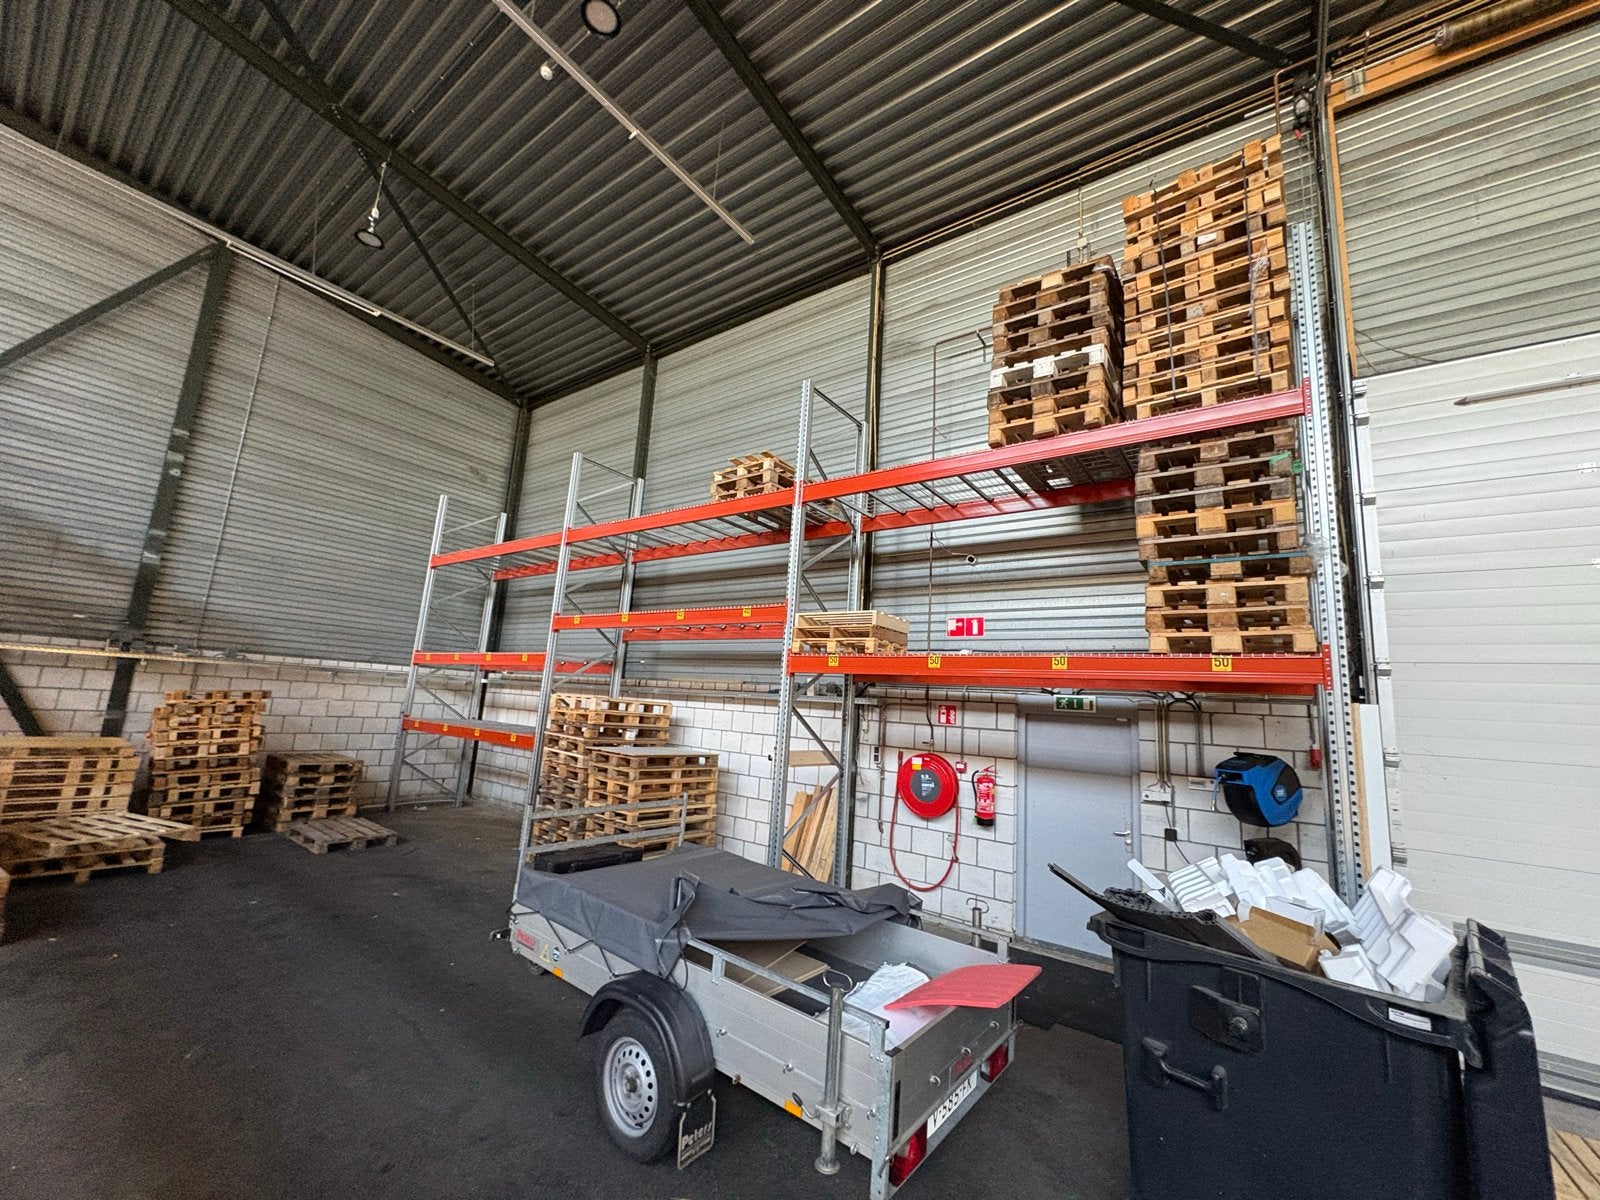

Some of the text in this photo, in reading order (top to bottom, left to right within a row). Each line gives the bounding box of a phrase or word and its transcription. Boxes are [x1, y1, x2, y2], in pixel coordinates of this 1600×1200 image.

[829, 655, 838, 663] 50
[929, 656, 939, 665] 50
[1053, 656, 1066, 666] 50
[1214, 656, 1230, 667] 50
